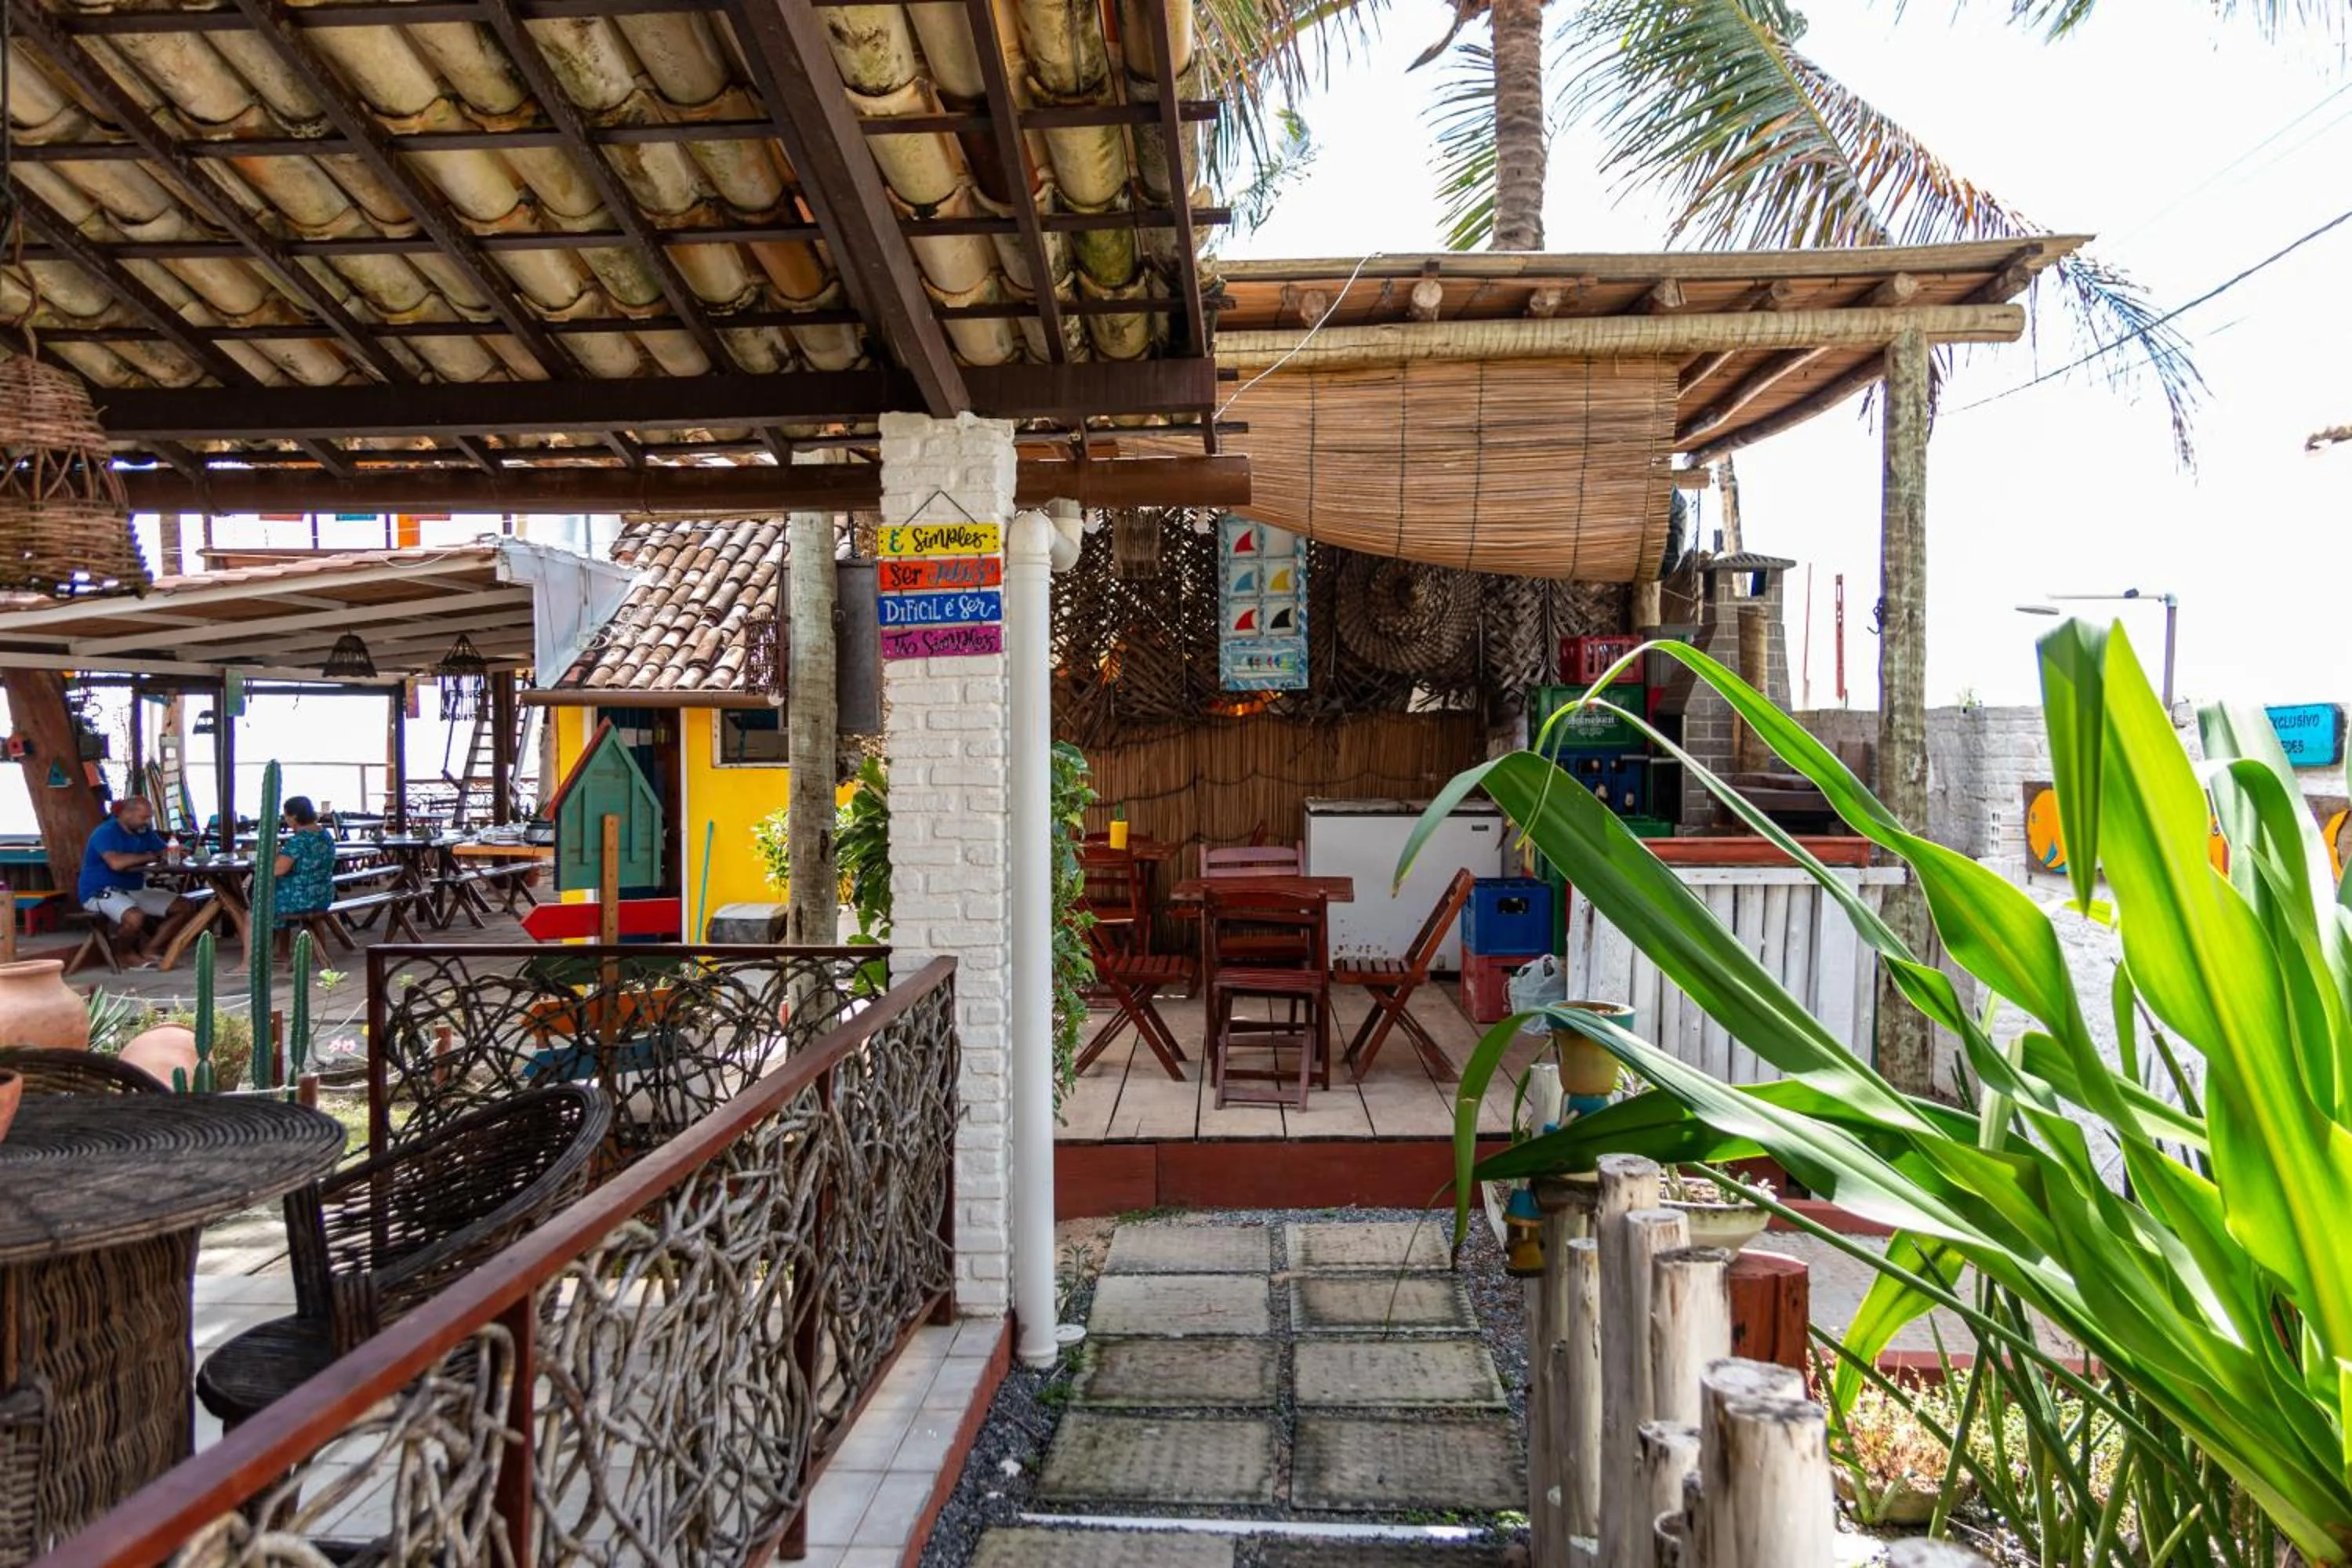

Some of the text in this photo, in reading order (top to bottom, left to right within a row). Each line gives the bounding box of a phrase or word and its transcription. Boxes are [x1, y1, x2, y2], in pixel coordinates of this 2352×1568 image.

[912, 528, 988, 553] Simples
[890, 564, 923, 586] Ser
[959, 595, 996, 620] Ser
